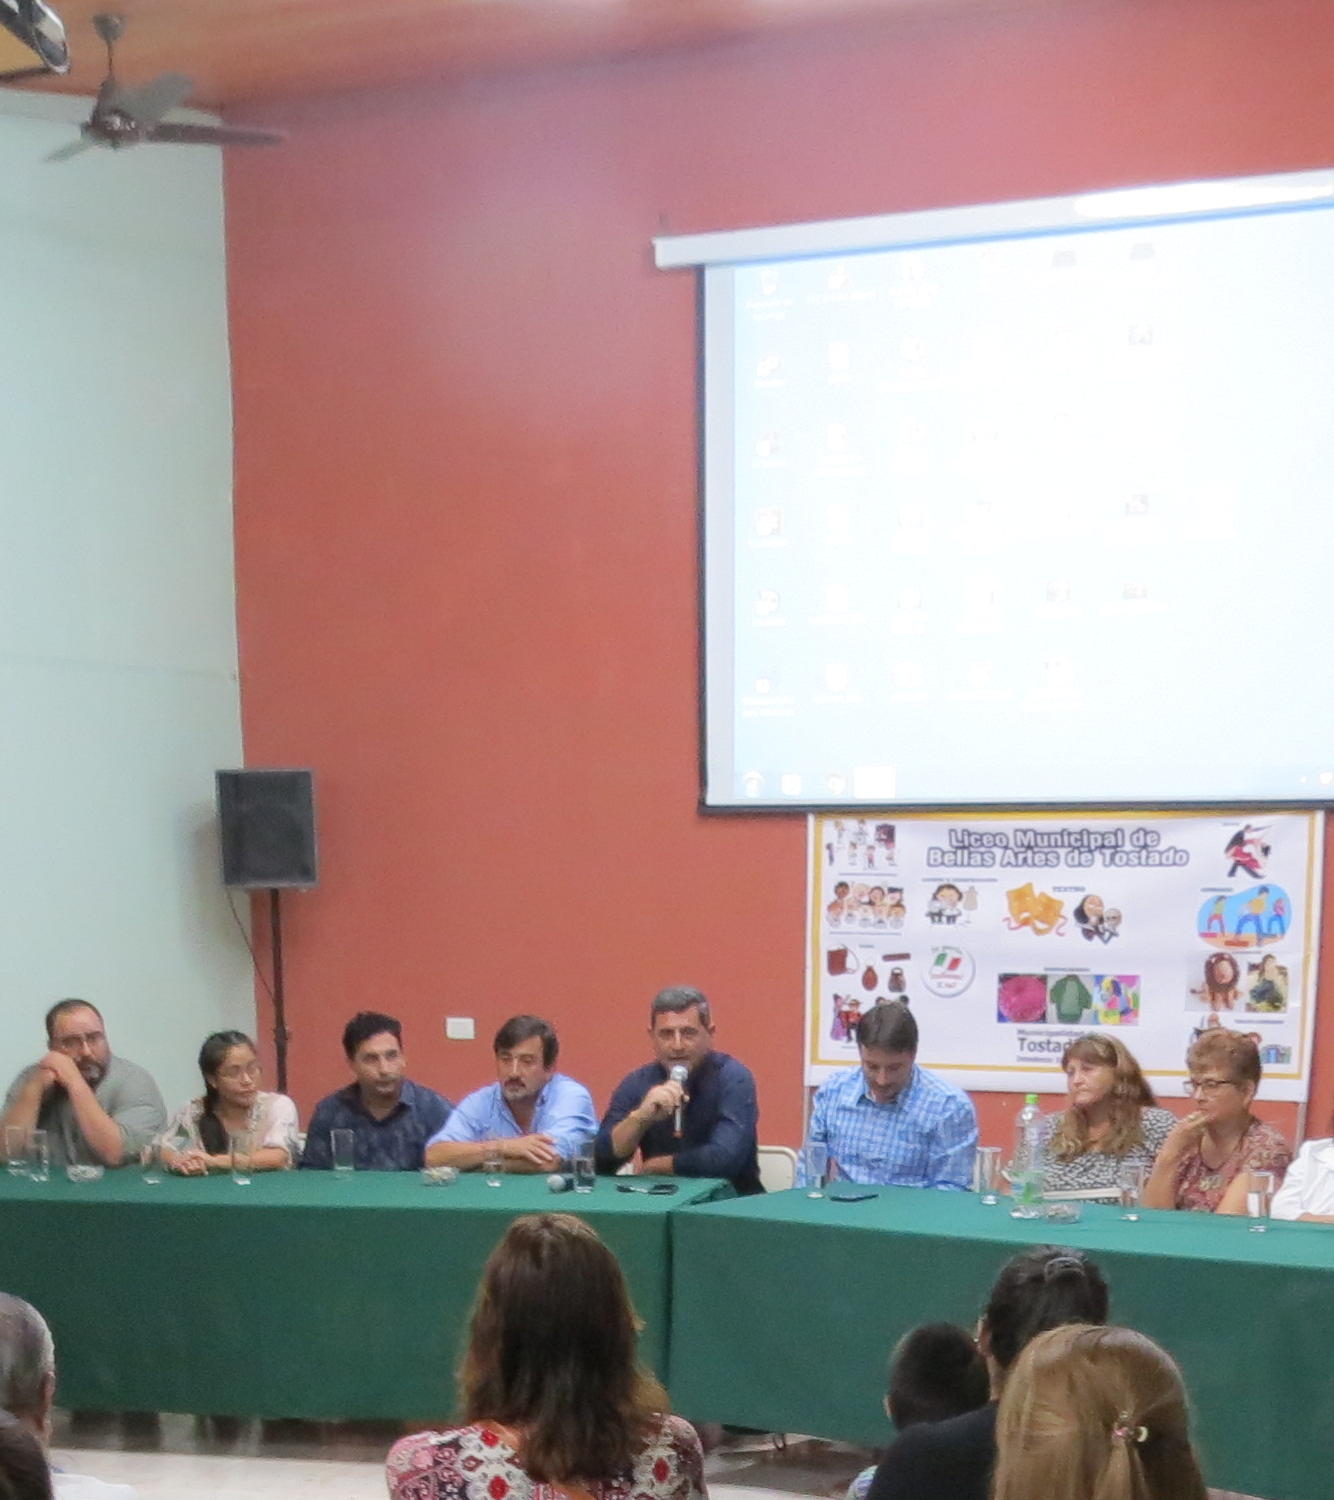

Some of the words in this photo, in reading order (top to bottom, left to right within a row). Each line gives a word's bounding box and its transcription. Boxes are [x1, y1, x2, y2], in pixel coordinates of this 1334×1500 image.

[948, 829, 1009, 849] Liceo
[1014, 829, 1124, 851] Municipal
[1130, 828, 1161, 848] de
[927, 847, 996, 868] Bellas
[1000, 849, 1061, 868] Artes
[1065, 849, 1096, 868] de
[1101, 848, 1190, 868] Tostado
[1017, 1037, 1074, 1054] Tostad
